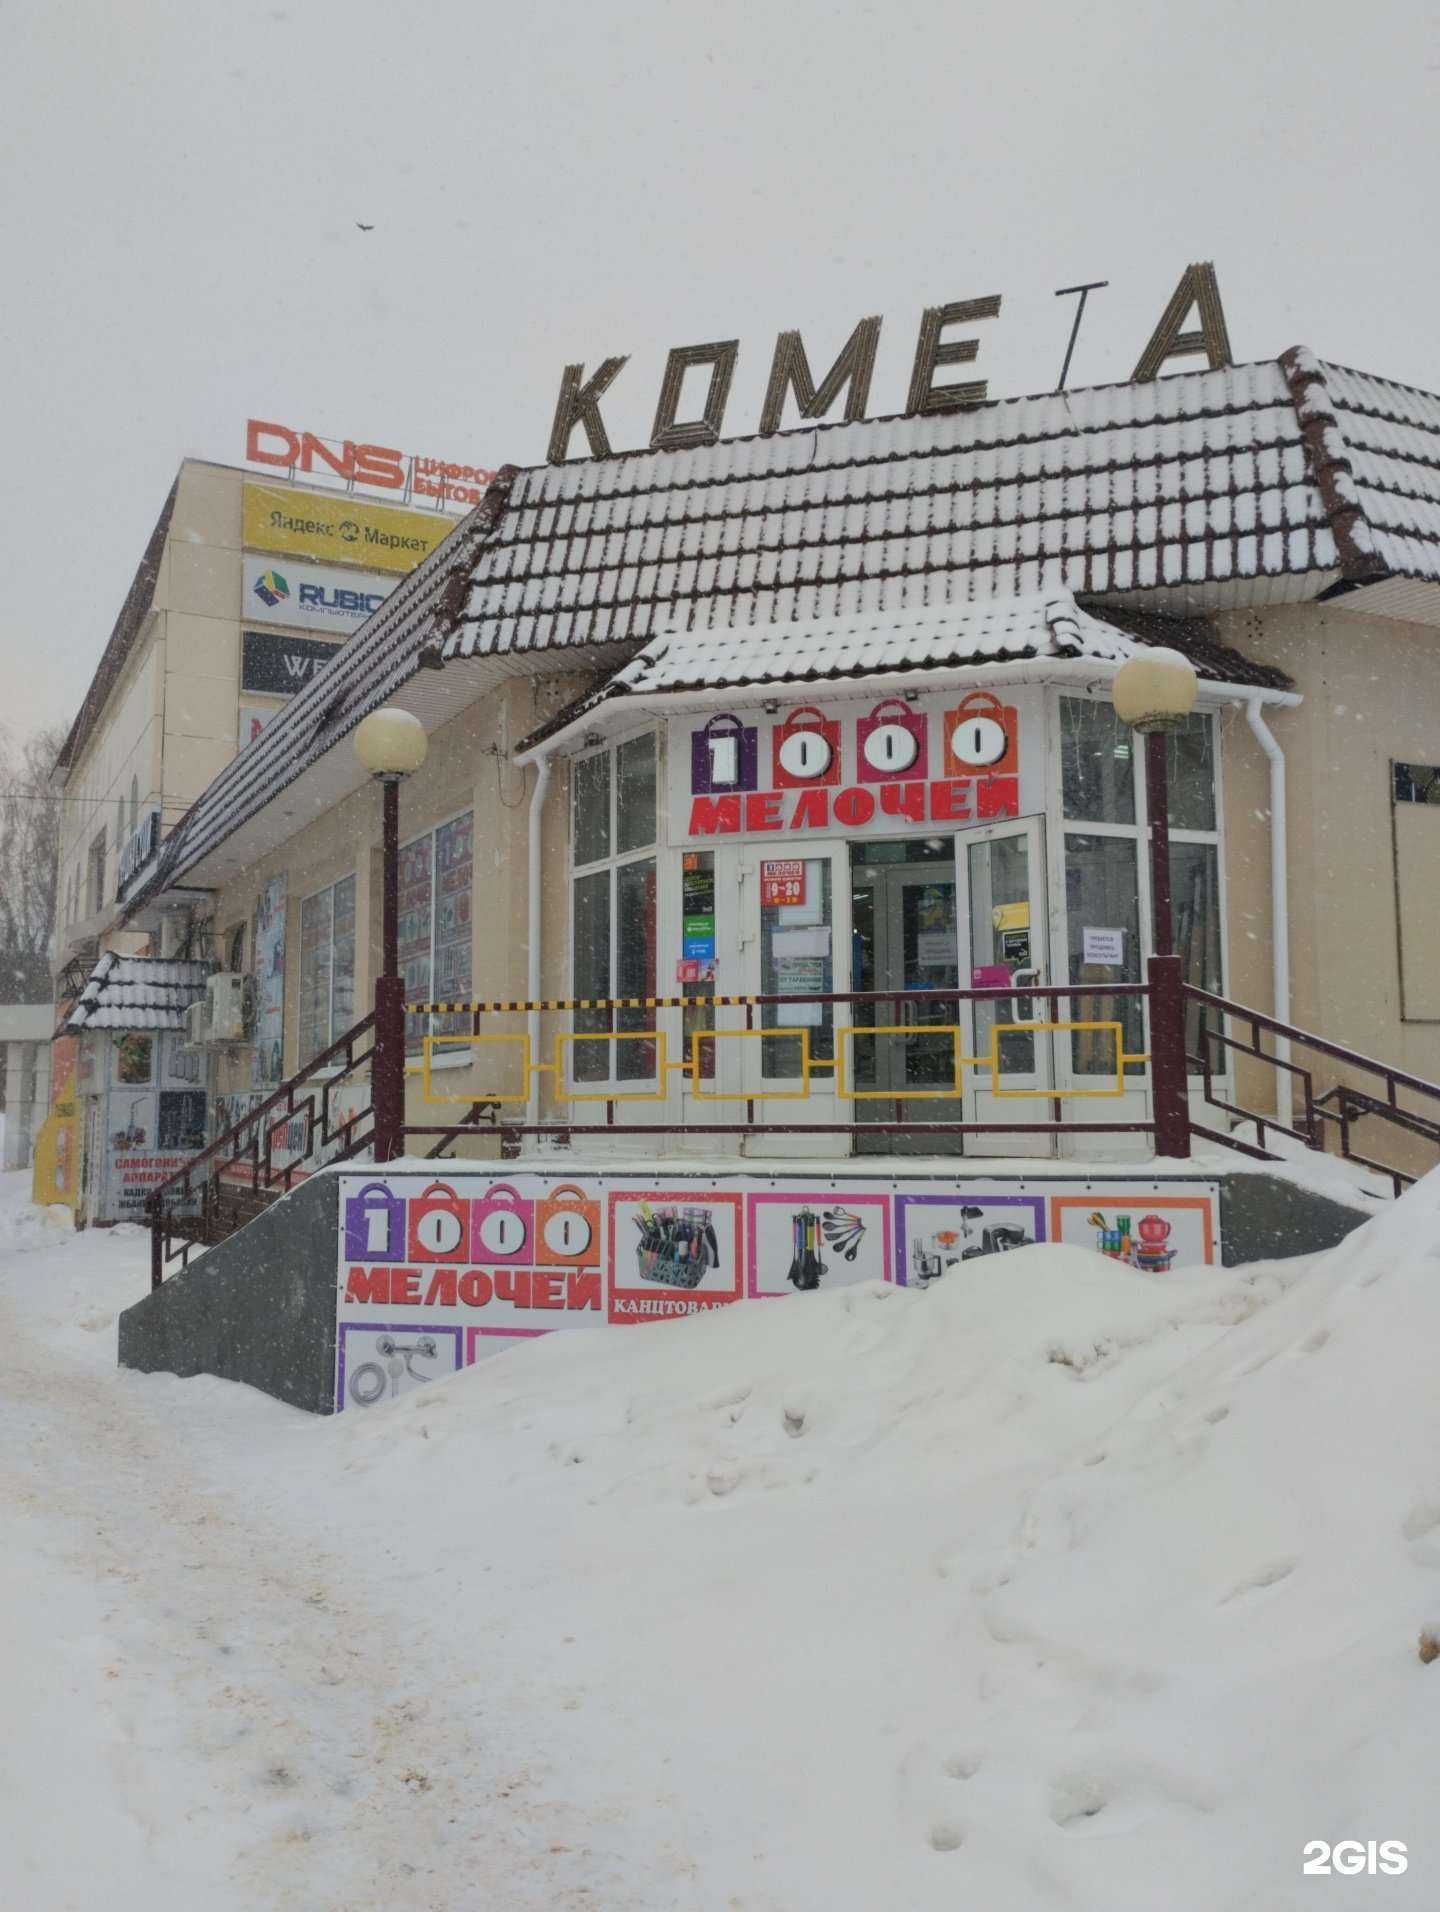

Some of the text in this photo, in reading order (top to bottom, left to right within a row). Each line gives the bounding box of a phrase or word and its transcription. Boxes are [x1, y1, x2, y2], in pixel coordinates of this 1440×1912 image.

[547, 261, 1232, 465] КОМЕТА
[246, 418, 405, 488] DNS
[271, 511, 429, 552] Яндекс Маркет
[708, 717, 1006, 784] 1000
[688, 772, 1019, 835] МЕЛОЧЕЙ
[364, 1208, 592, 1256] 1000
[345, 1267, 601, 1309] МЕЛОЧЕЙ
[614, 1299, 730, 1315] КАНЦТОВАР
